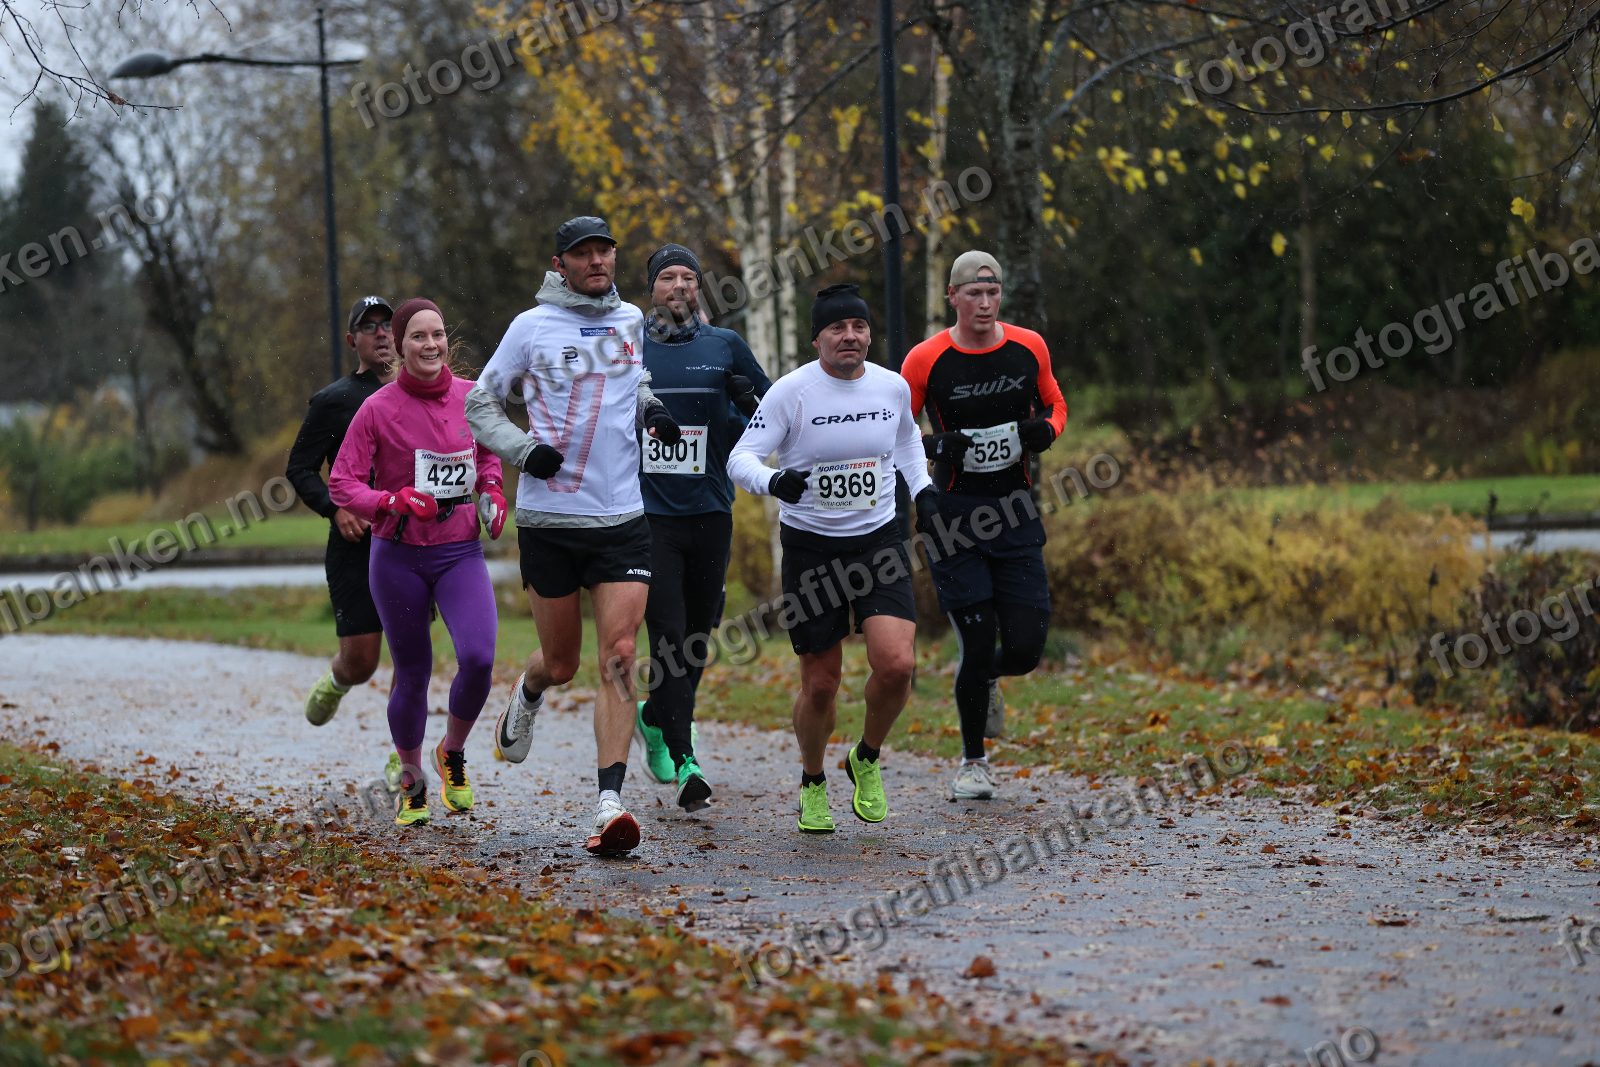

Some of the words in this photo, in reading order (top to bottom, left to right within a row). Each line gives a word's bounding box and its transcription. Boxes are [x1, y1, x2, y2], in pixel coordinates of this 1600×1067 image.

[811, 412, 880, 426] CRAFT
[648, 439, 698, 462] 3001
[974, 438, 1011, 464] 525
[427, 464, 467, 487] 422
[817, 461, 877, 473] NORGESTESTEN
[818, 471, 876, 499] 9369
